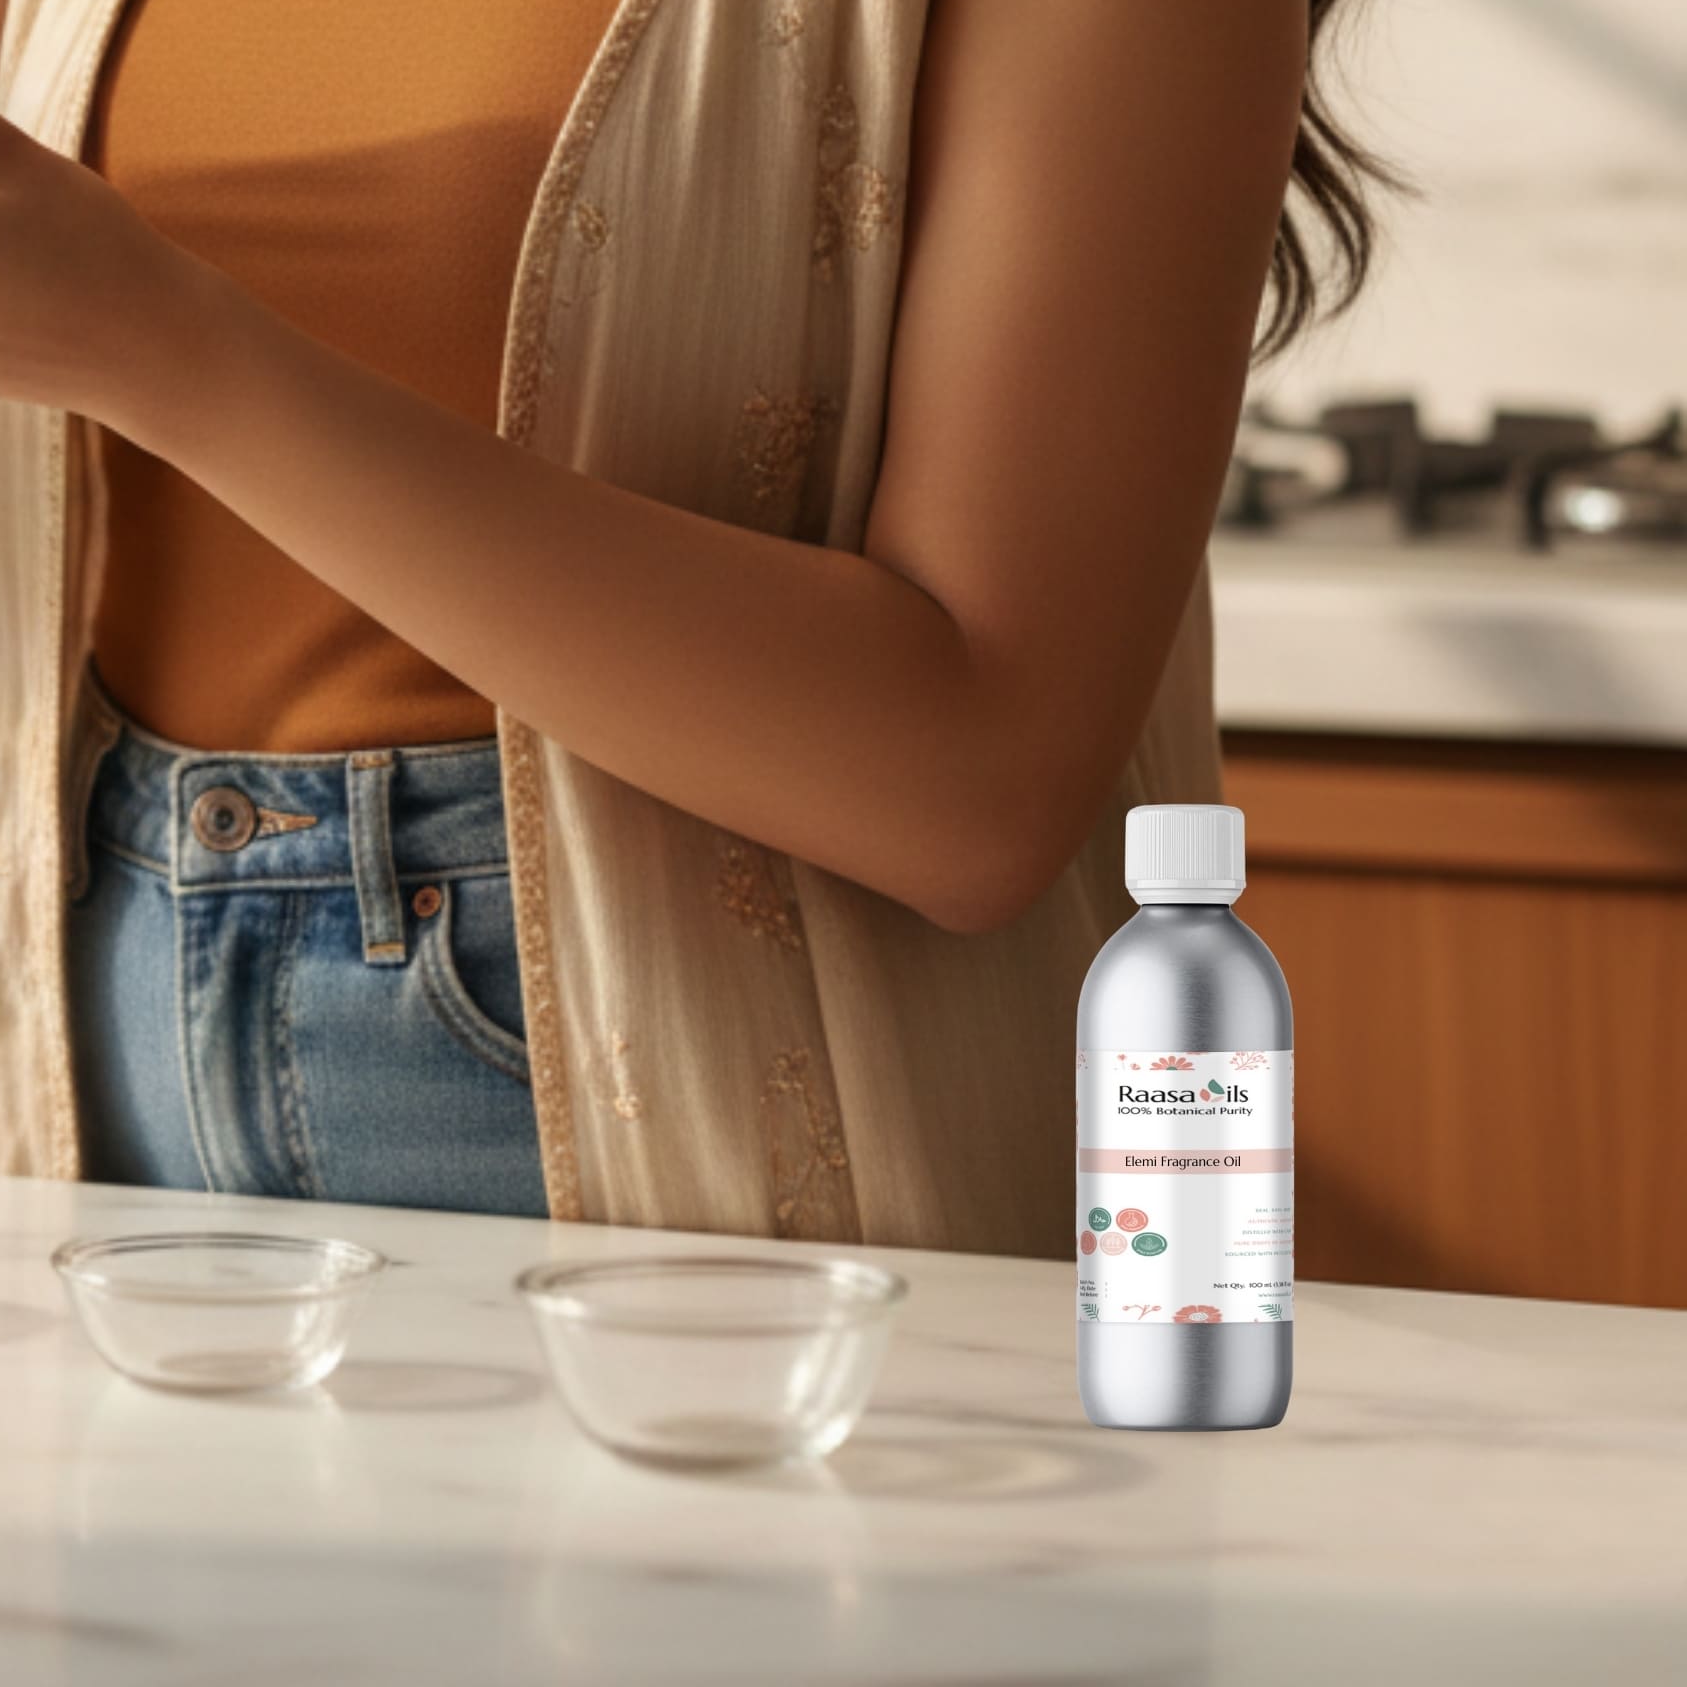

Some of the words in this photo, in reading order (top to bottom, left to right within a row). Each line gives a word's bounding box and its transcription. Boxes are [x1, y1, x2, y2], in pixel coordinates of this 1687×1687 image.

[1119, 1085, 1196, 1103] Raasa
[1118, 1106, 1152, 1115] 100%
[1156, 1107, 1216, 1115] Botanical
[1220, 1107, 1253, 1116] Purity
[1125, 1156, 1157, 1167] Elemi
[1161, 1156, 1220, 1170] Fragrance
[1224, 1156, 1241, 1167] Oil
